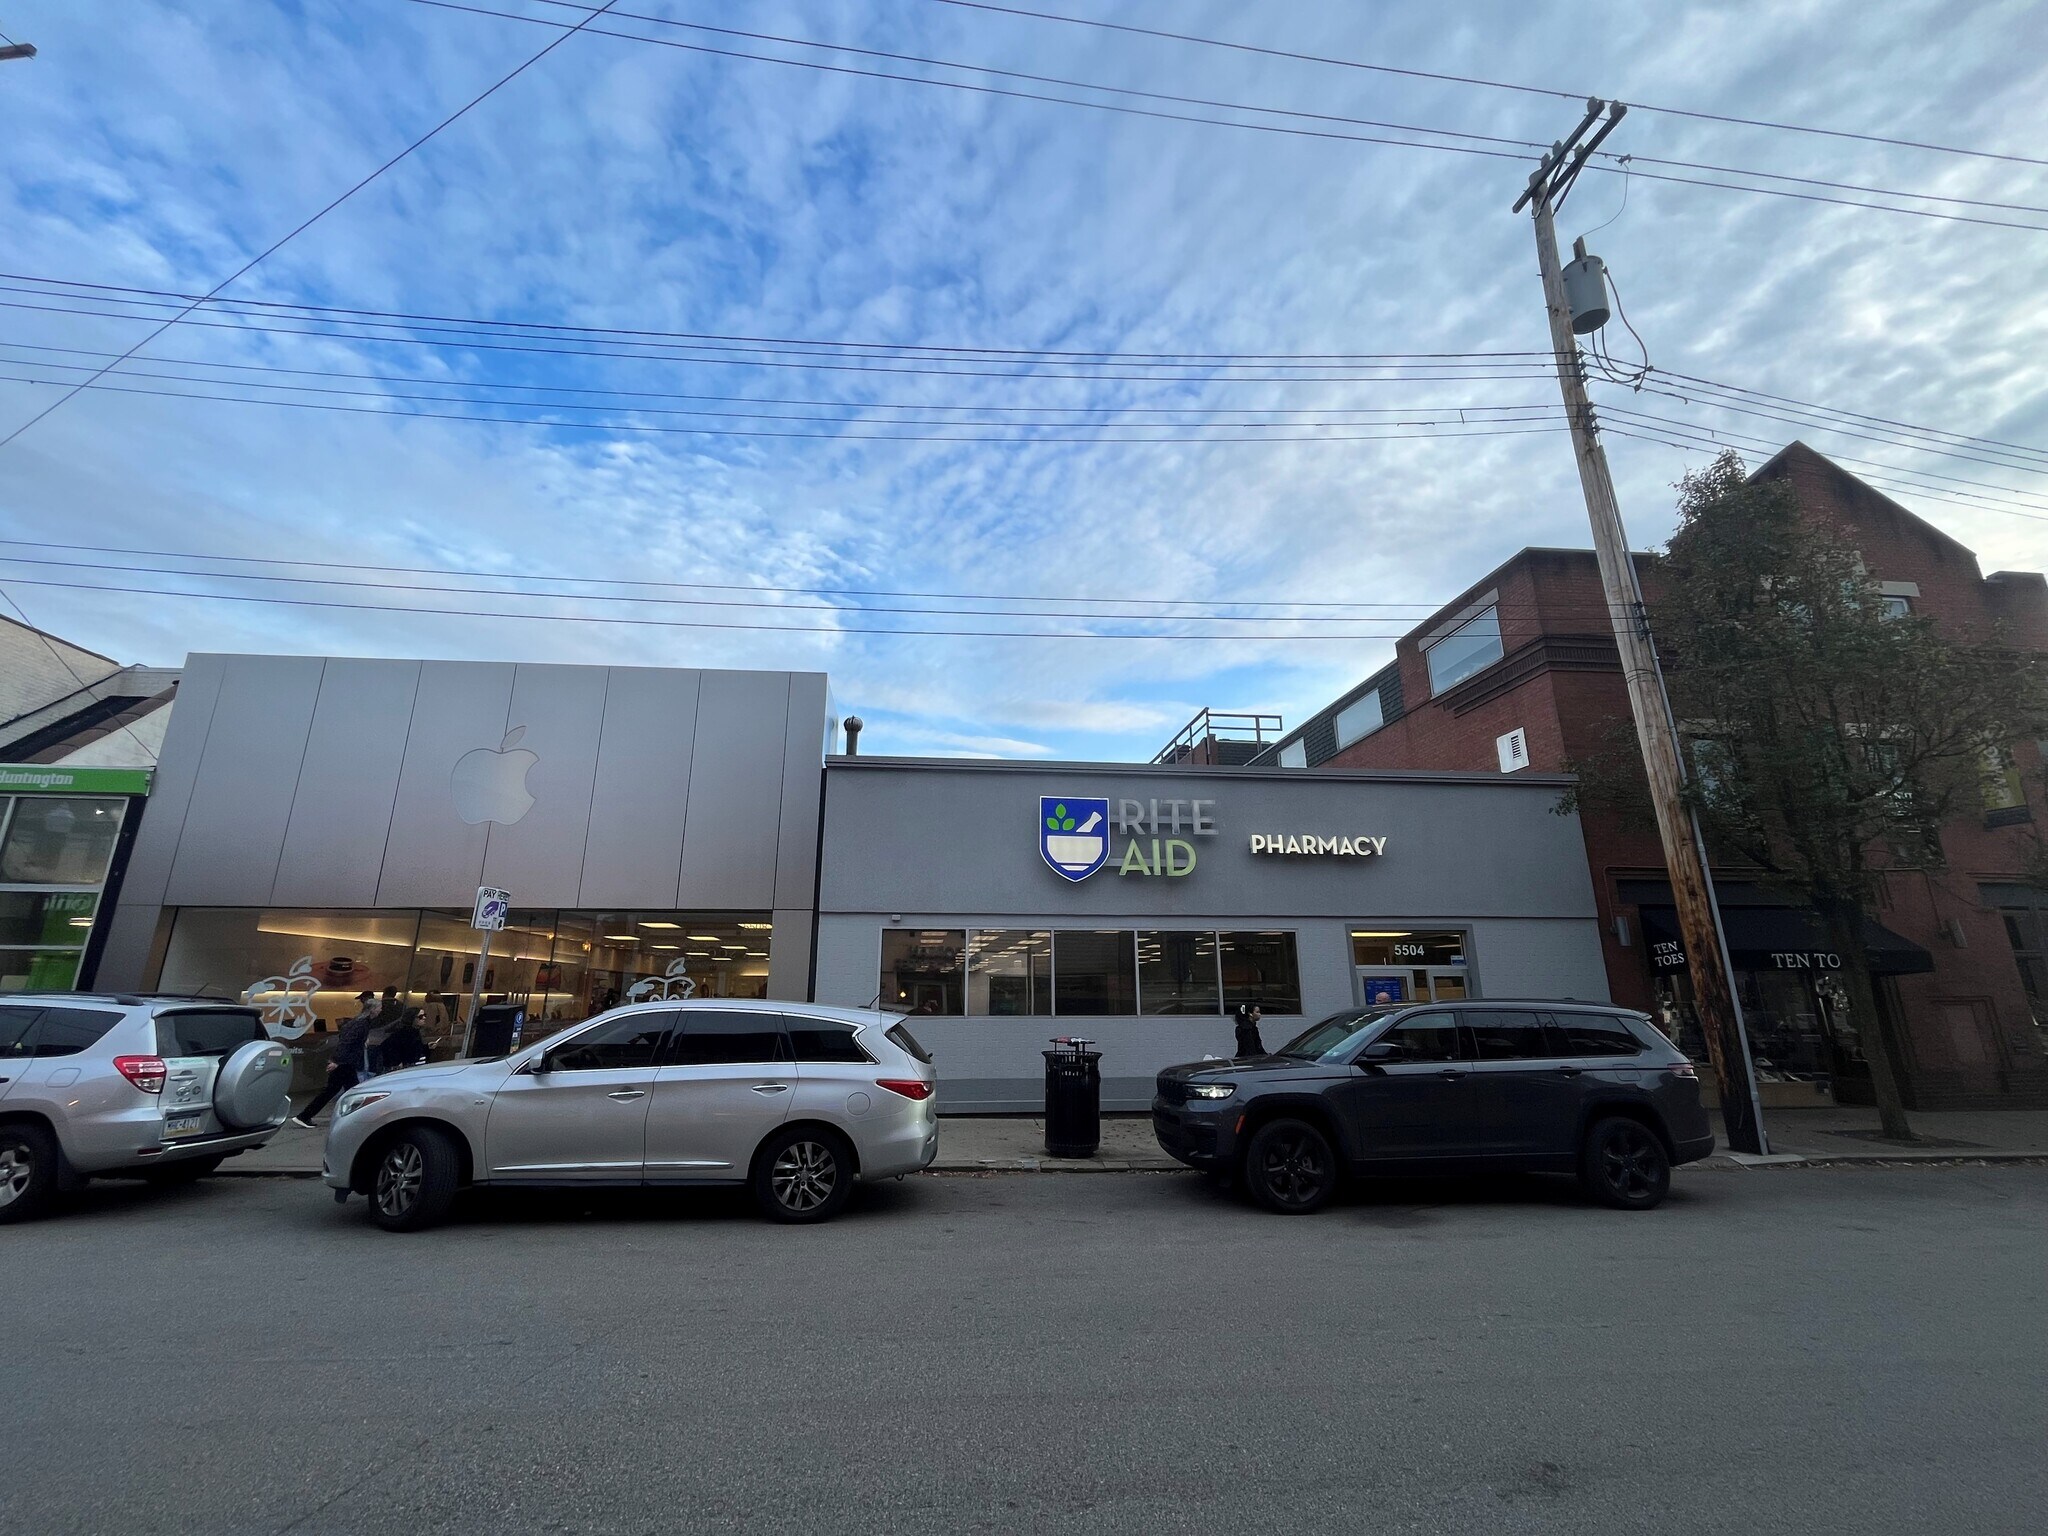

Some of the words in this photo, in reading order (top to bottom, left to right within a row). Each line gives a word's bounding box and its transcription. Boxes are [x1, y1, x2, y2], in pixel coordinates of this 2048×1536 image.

[1118, 798, 1219, 836] RITE
[1250, 834, 1387, 856] PHARMACY
[1118, 838, 1197, 877] AID
[483, 889, 497, 899] PAY
[1394, 944, 1425, 956] 5504
[1653, 940, 1678, 954] TEN
[1654, 952, 1685, 967] TOES
[1771, 953, 1811, 968] TEN
[1813, 953, 1841, 968] TO
